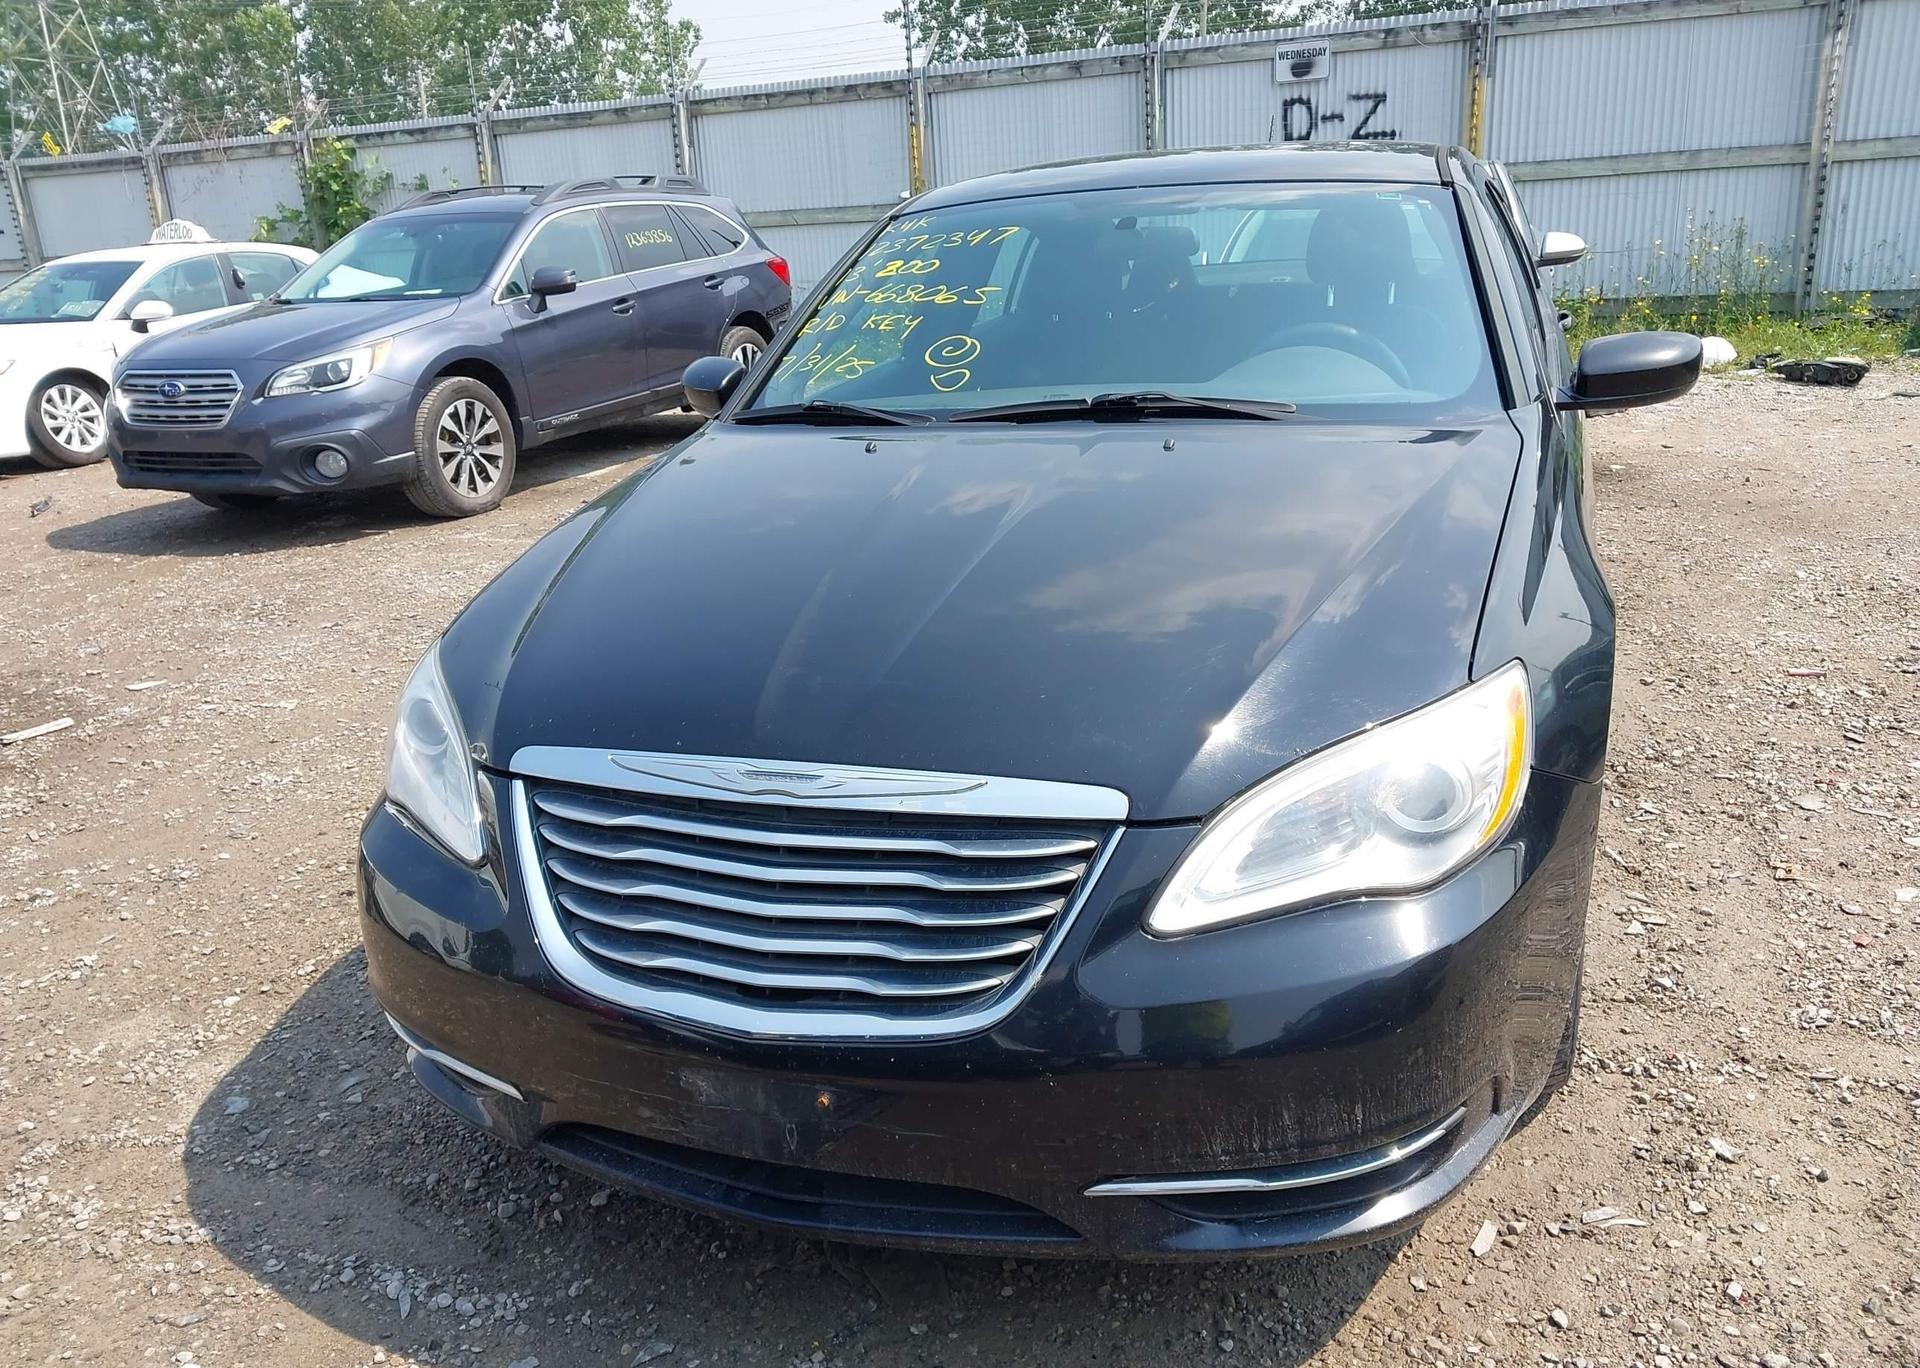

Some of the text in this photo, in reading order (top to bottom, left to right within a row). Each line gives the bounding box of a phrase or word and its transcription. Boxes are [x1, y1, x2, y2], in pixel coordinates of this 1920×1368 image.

[1278, 46, 1328, 61] WEDNESDAY
[1283, 91, 1397, 141] D-Z
[155, 222, 193, 240] WATERLOO
[862, 313, 924, 340] KEY
